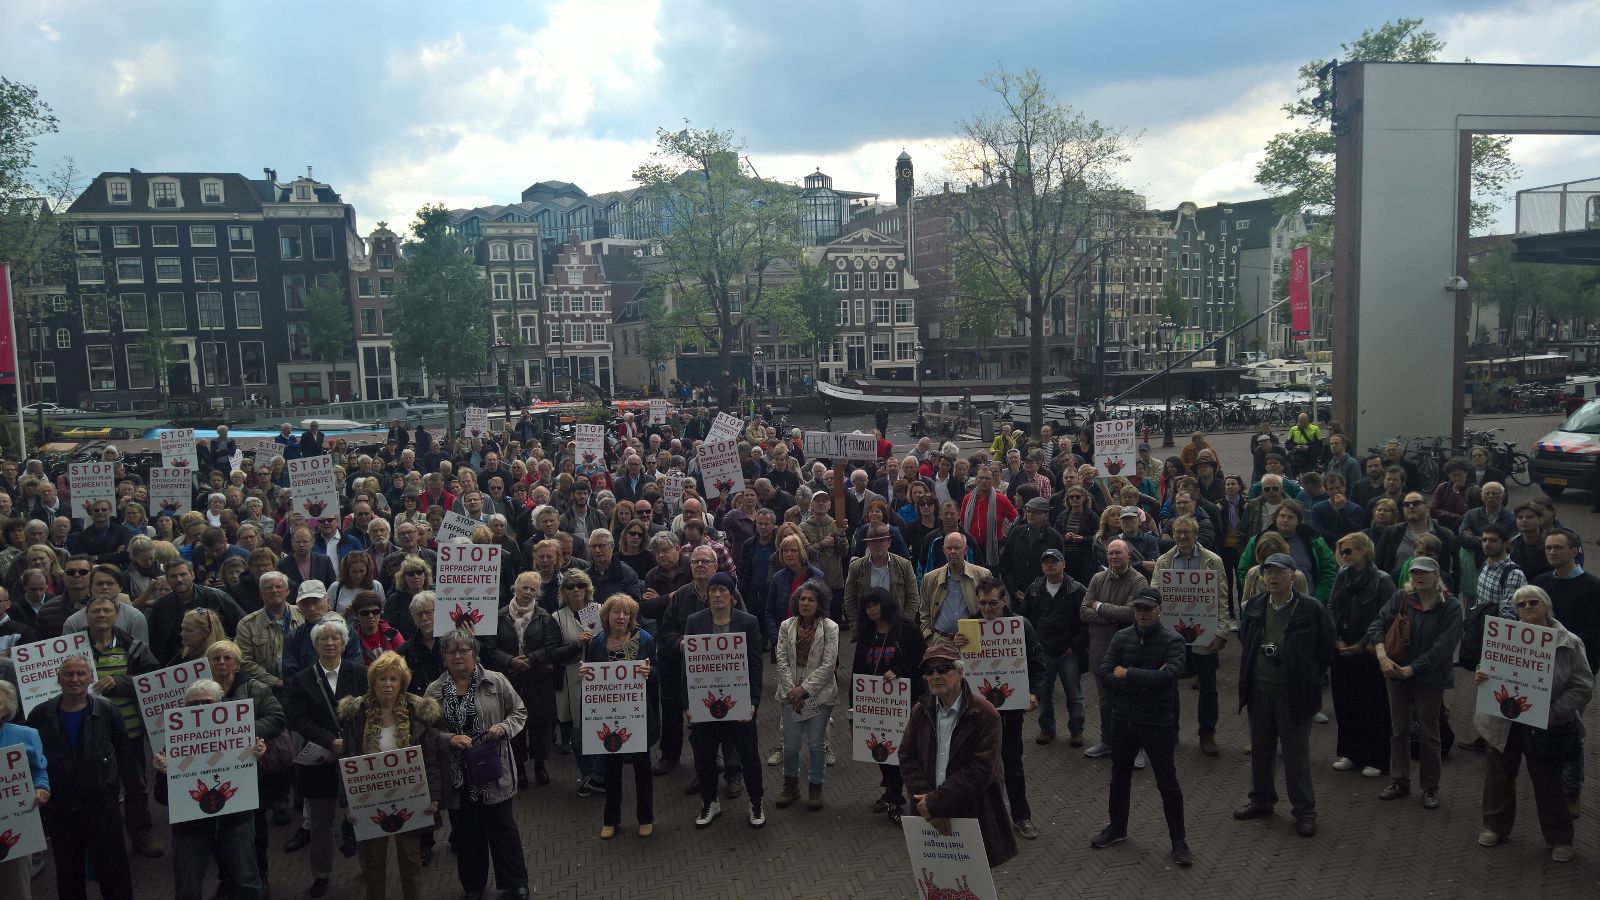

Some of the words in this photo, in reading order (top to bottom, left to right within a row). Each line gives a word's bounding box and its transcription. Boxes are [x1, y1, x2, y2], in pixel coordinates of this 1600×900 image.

[717, 413, 742, 428] STOP
[1095, 421, 1133, 433] STOP
[161, 429, 193, 439] STOP
[576, 425, 603, 433] STOP
[258, 441, 284, 451] STOP
[699, 440, 735, 457] STOP
[71, 464, 111, 475] STOP
[289, 458, 330, 472] STOP
[152, 469, 190, 478] STOP
[455, 515, 475, 526] STOP
[440, 545, 498, 562] STOP
[439, 564, 478, 572] ERFPACHT
[478, 564, 498, 572] PLAN
[1162, 571, 1214, 585] STOP
[978, 619, 1021, 636] TOP
[1487, 620, 1553, 648] STOP
[16, 635, 85, 662] STOP
[687, 635, 743, 652] STOP
[1002, 637, 1022, 645] PLAN
[688, 653, 725, 662] ERFPACHT
[726, 652, 745, 660] PLAN
[1486, 639, 1527, 656] ERFPACHT
[1529, 649, 1551, 661] PLAN
[137, 661, 205, 693] STOP
[585, 664, 643, 682] STOP
[585, 683, 622, 692] ERFPACHT
[624, 682, 643, 691] PLAN
[855, 678, 908, 696] STOP
[142, 686, 186, 705] ERFPACHT
[855, 695, 889, 704] ERFPACHT
[890, 698, 907, 706] PLAN
[168, 703, 250, 731] STOP
[169, 728, 222, 744] ERFPACHT
[225, 725, 251, 736] PLAN
[344, 749, 418, 775] STOP
[347, 770, 394, 785] ERFPACHT
[397, 765, 421, 776] PLAN
